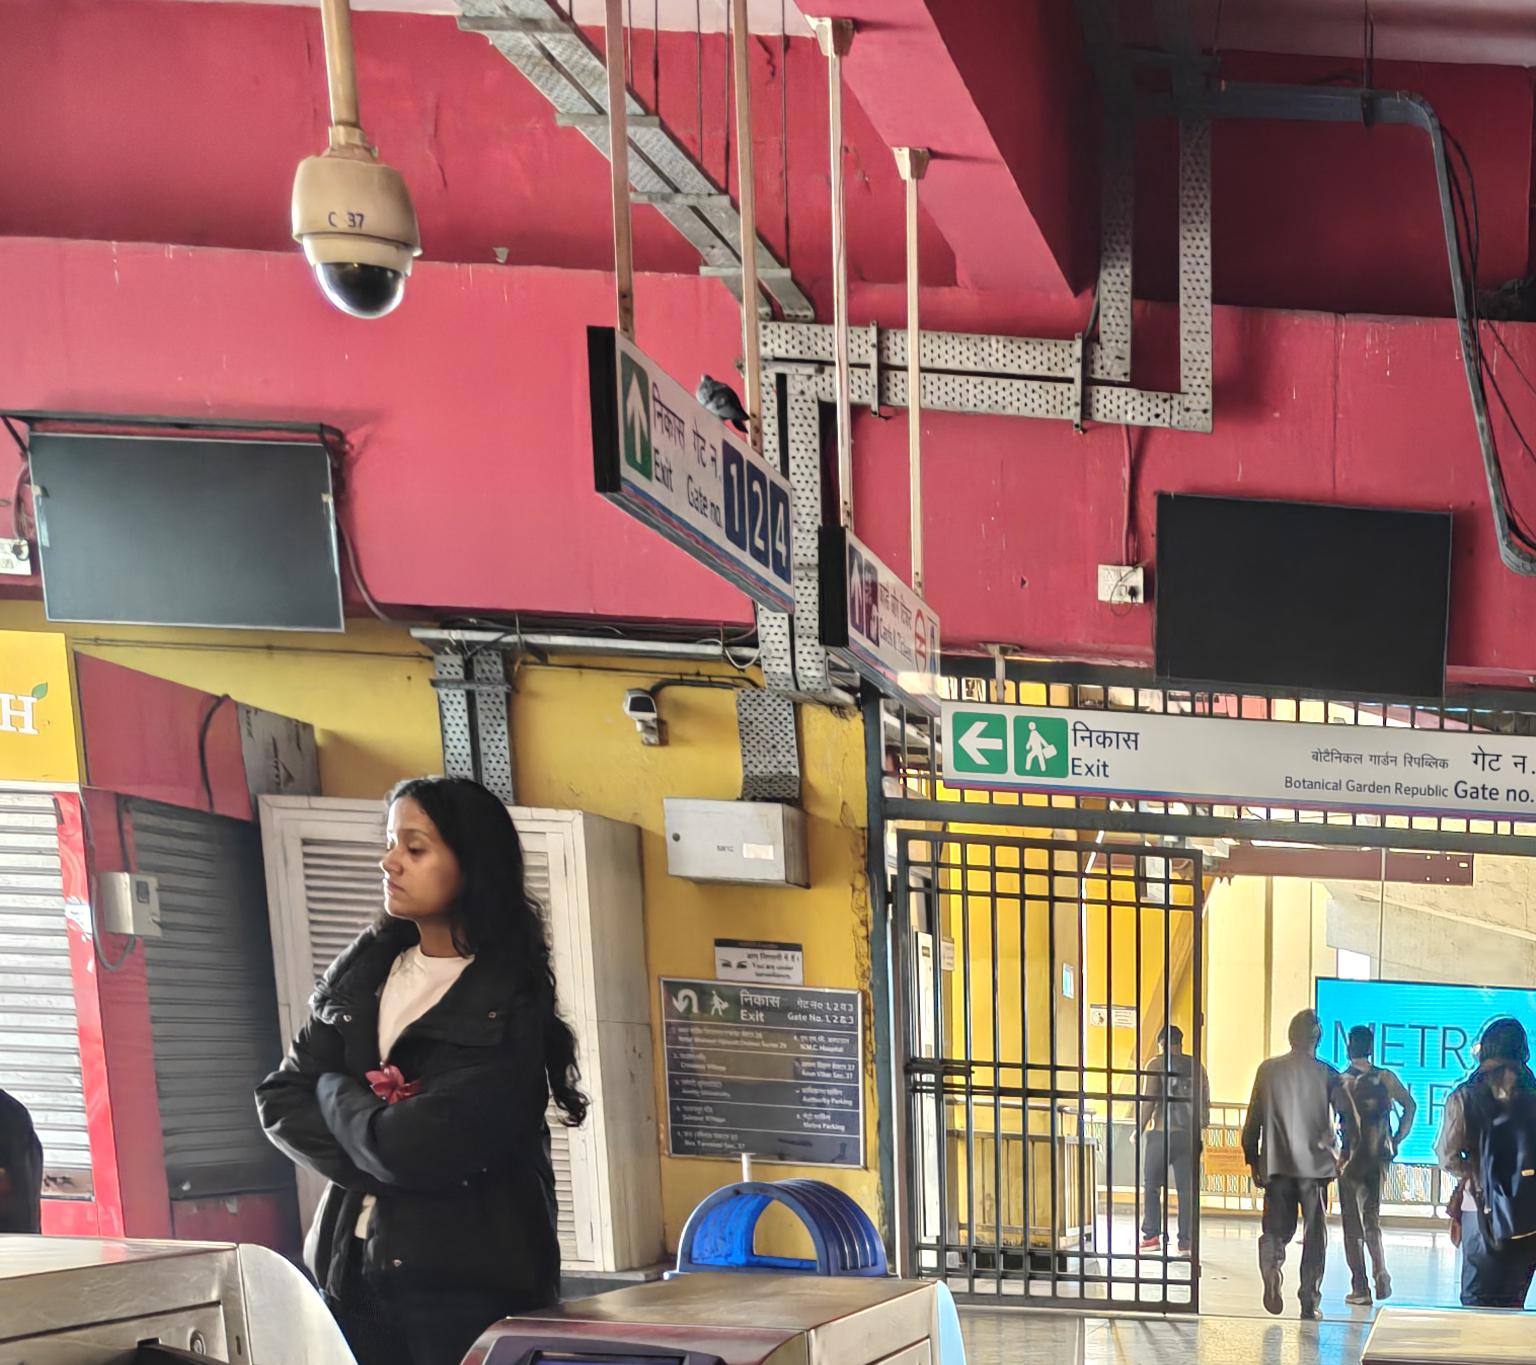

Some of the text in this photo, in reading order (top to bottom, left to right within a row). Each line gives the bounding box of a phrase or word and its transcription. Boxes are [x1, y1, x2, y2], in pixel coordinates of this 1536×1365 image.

[347, 212, 364, 228] 37
[653, 382, 685, 450] निकास
[692, 417, 706, 467] गेट
[653, 447, 673, 492] Exit
[687, 474, 709, 519] Gate
[730, 463, 787, 567] 1 2 4
[1072, 721, 1140, 750] निकास
[1071, 757, 1109, 778] Exit
[1311, 748, 1363, 765] बोटैनिकल
[1368, 750, 1398, 767] गार्डन
[1403, 752, 1449, 770] रिपब्लिक
[1471, 745, 1502, 772] गेट
[1284, 776, 1535, 804] Botanical Garden Republic Gate no.
[740, 989, 780, 1008] निकास
[740, 1010, 765, 1023] Exit
[787, 1012, 808, 1022] Gate
[1333, 1020, 1479, 1071] METR
